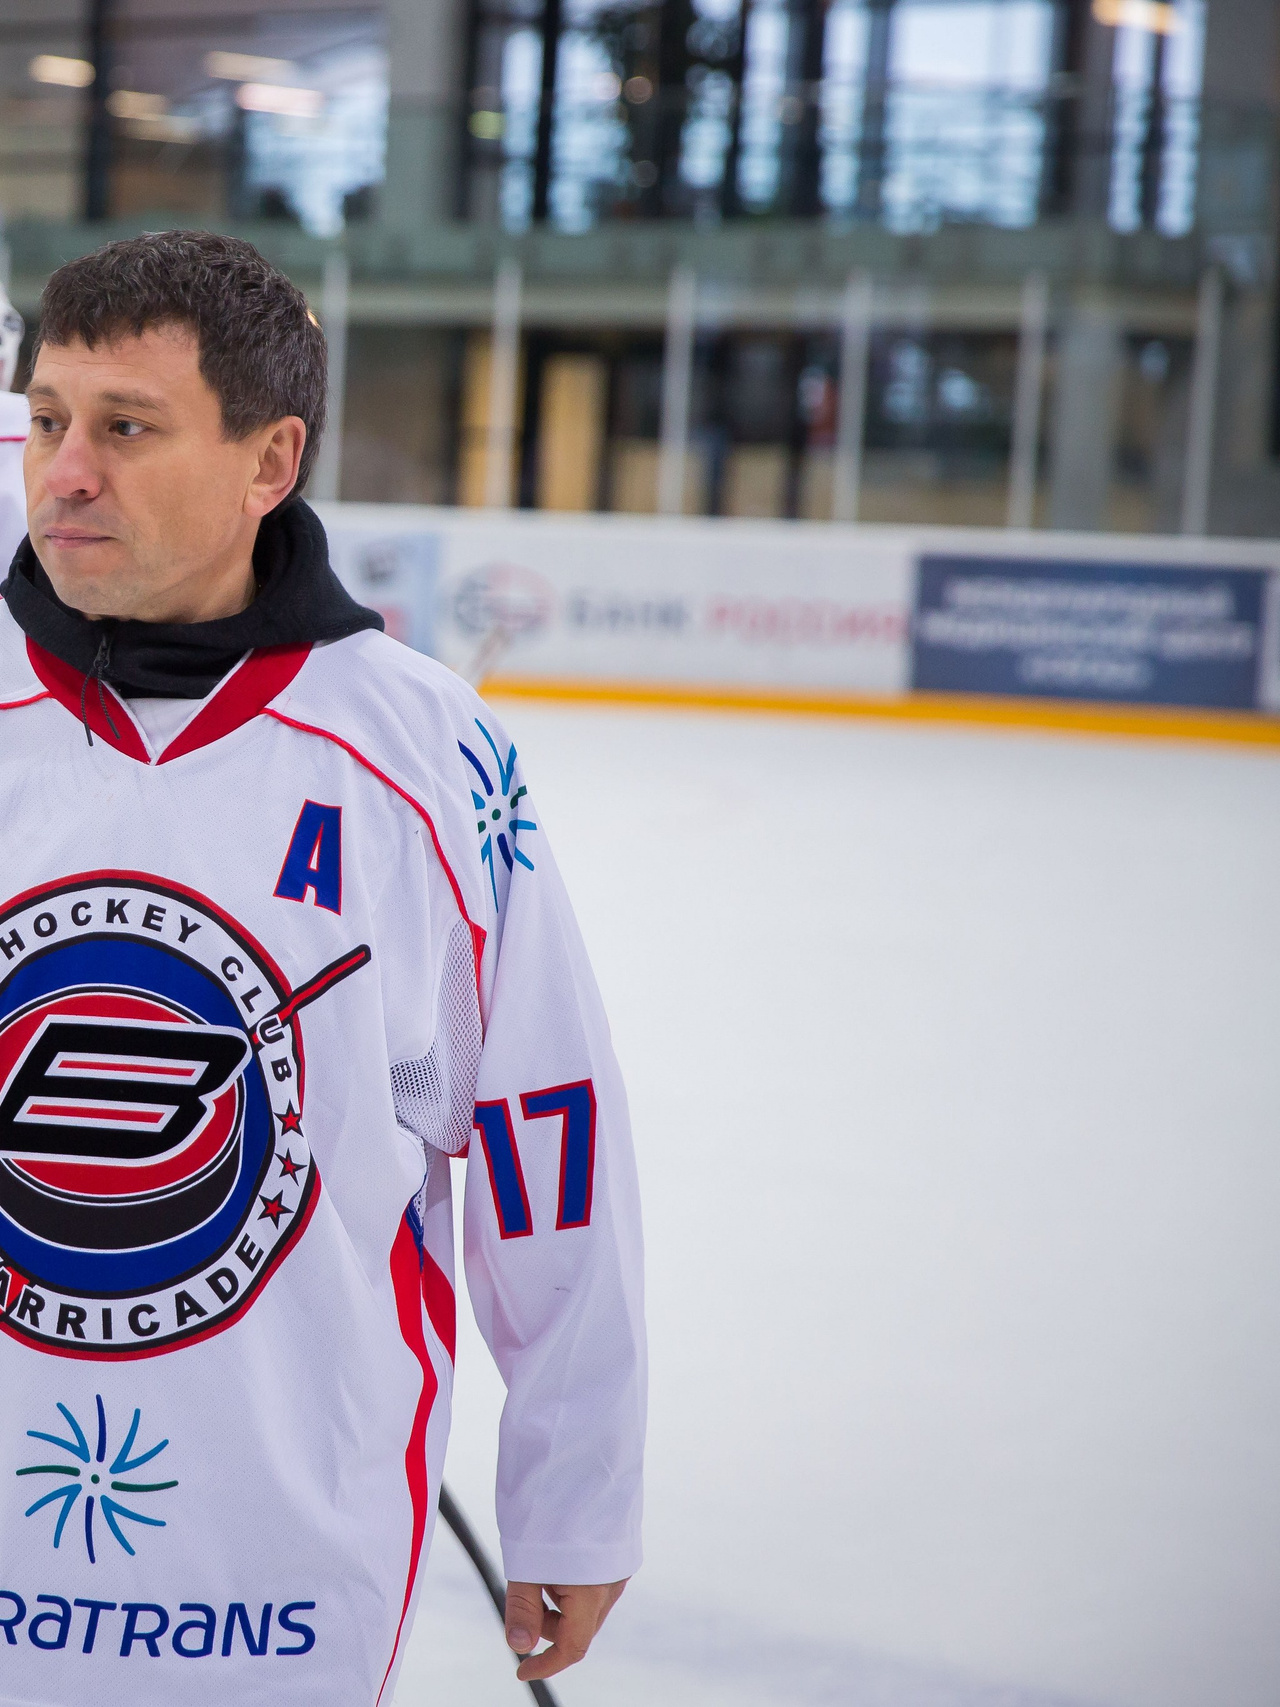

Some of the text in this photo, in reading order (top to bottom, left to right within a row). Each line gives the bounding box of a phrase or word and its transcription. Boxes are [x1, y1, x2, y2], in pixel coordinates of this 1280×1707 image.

[273, 798, 342, 916] A
[220, 955, 293, 1083] CLUB
[472, 1078, 597, 1240] 17
